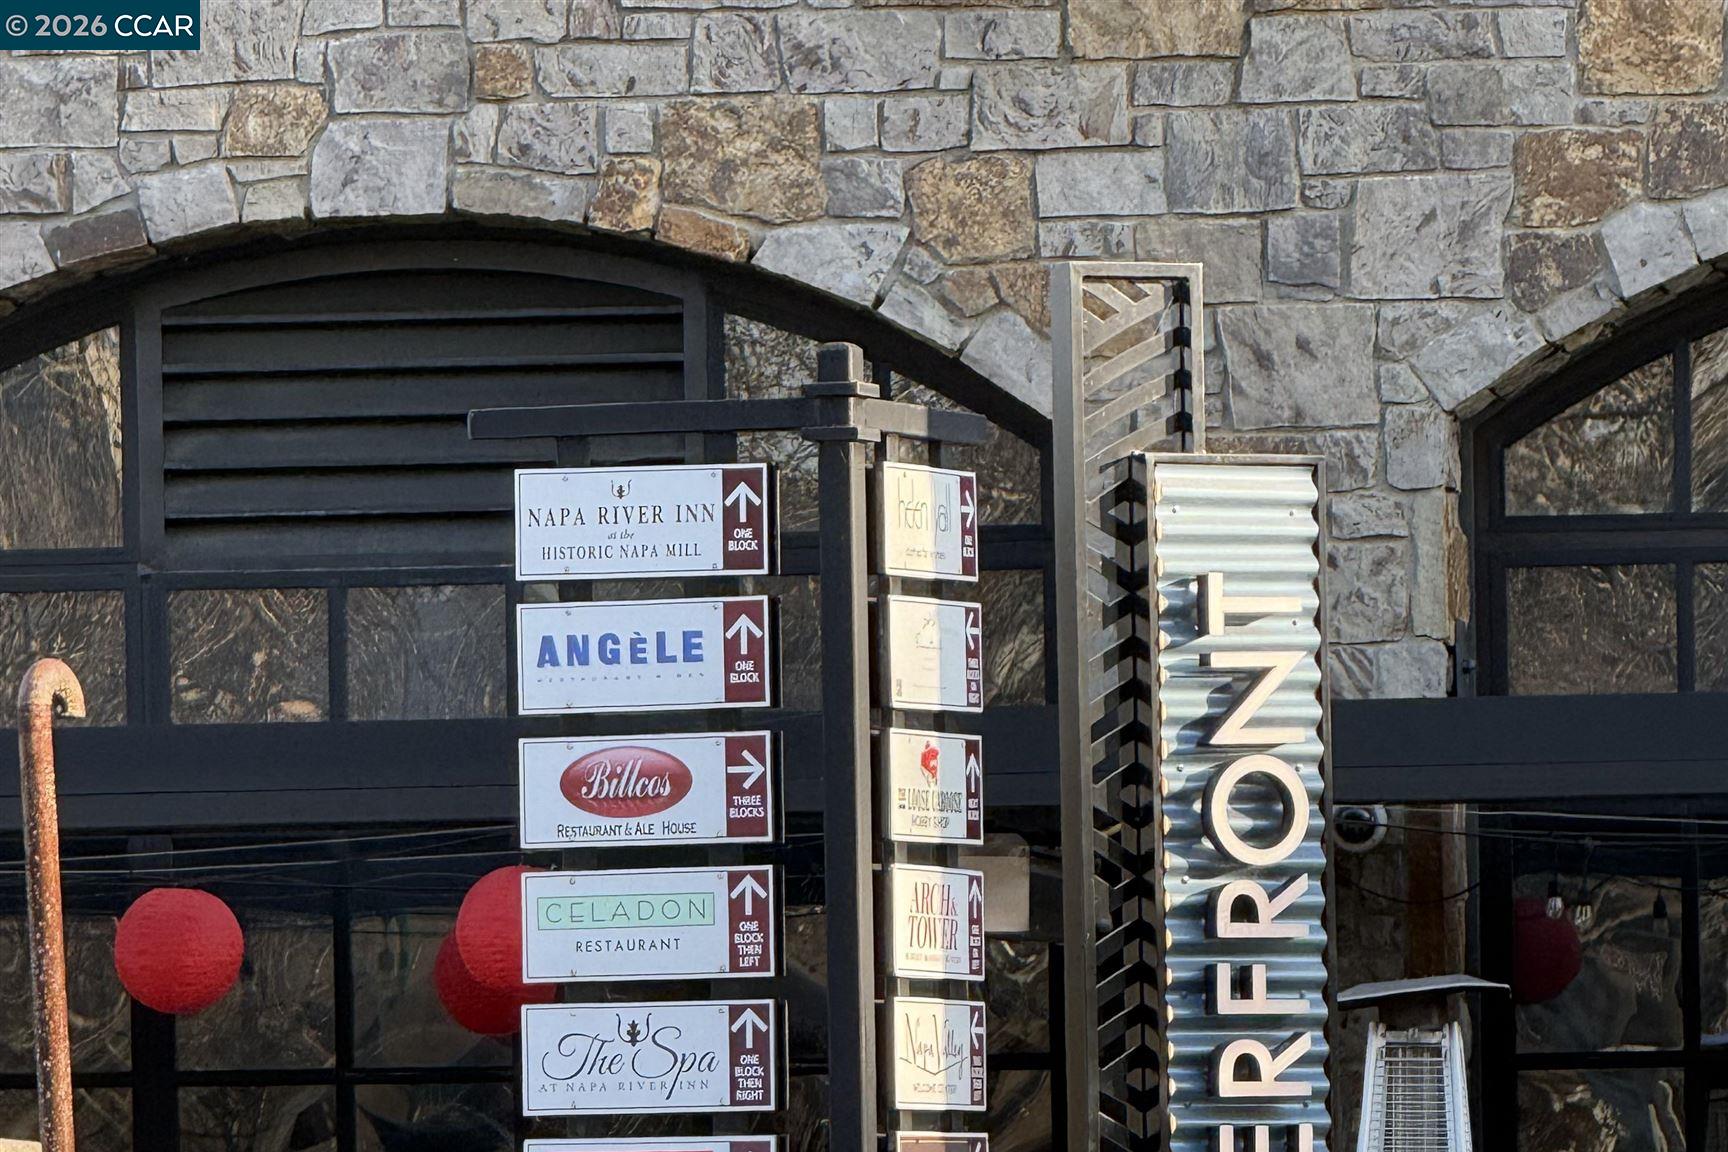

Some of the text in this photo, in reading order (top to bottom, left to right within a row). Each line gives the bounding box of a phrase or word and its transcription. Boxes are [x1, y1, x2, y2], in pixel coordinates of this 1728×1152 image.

[528, 503, 715, 528] NAPA RIVER INN
[619, 529, 635, 540] the
[733, 528, 753, 539] ONE
[728, 540, 758, 551] BLOCK
[542, 543, 702, 561] HISTORIC NAPA MILL
[536, 630, 705, 669] ANGÈLE
[735, 661, 754, 672] ONE
[730, 672, 760, 684] BLOCK
[581, 757, 672, 800] Billcos
[733, 795, 762, 806] THREE
[730, 807, 764, 818] BLOCKS
[910, 881, 950, 916] ARCH
[546, 898, 706, 924] CELADON
[739, 920, 759, 932] ONE
[908, 914, 958, 950] TOWER
[734, 932, 764, 944] BLOCK
[576, 938, 681, 953] RESTAURANT
[738, 944, 762, 956] THEN
[739, 956, 761, 968] LEFT
[542, 1026, 720, 1100] The Spa
[740, 1054, 760, 1065] ONE
[734, 1066, 764, 1077] BLOCK
[538, 1080, 710, 1093] AT NAPA RIVER INN
[738, 1078, 762, 1088] THEN
[736, 1090, 764, 1100] RIGHT
